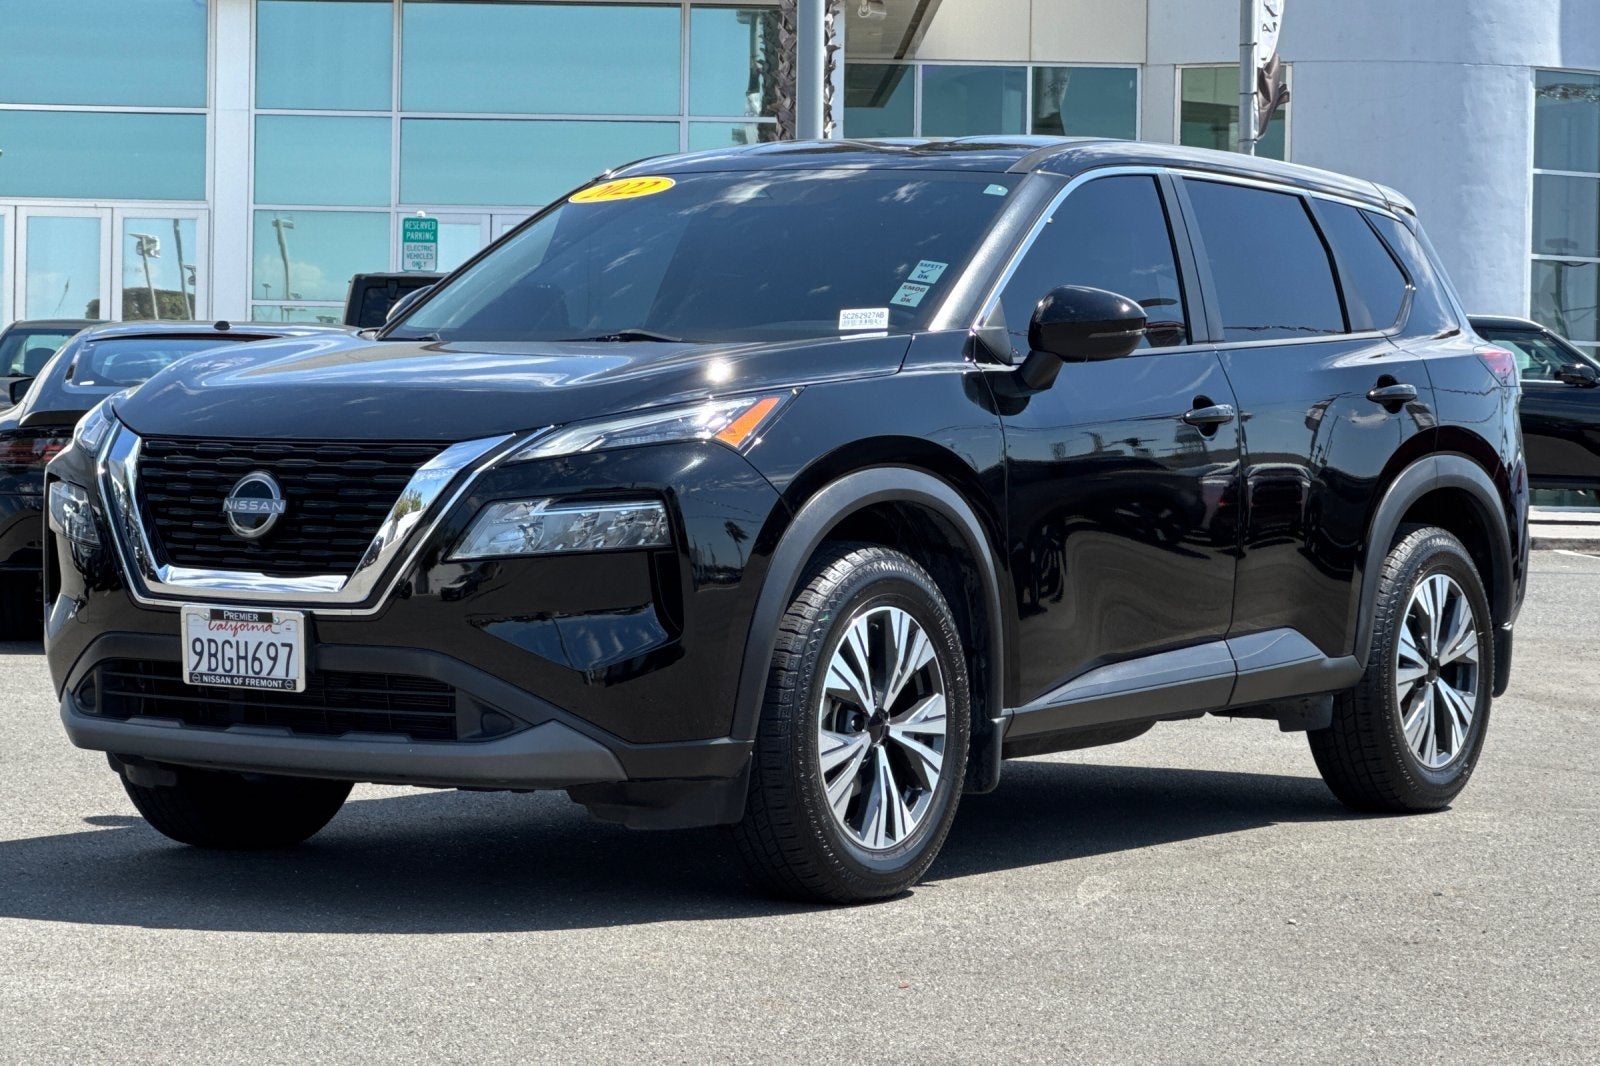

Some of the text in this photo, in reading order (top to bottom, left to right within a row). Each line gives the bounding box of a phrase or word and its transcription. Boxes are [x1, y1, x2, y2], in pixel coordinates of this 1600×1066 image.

[405, 221, 436, 230] RESERVED
[406, 231, 434, 240] PARKING
[902, 285, 926, 293] SMOG
[224, 500, 283, 511] NISSAN
[223, 610, 259, 621] PREMIER
[208, 620, 273, 637] California
[191, 637, 294, 678] 9BGH697
[202, 674, 231, 684] NISSAN
[233, 676, 244, 685] OF
[245, 677, 283, 688] FREMONT
